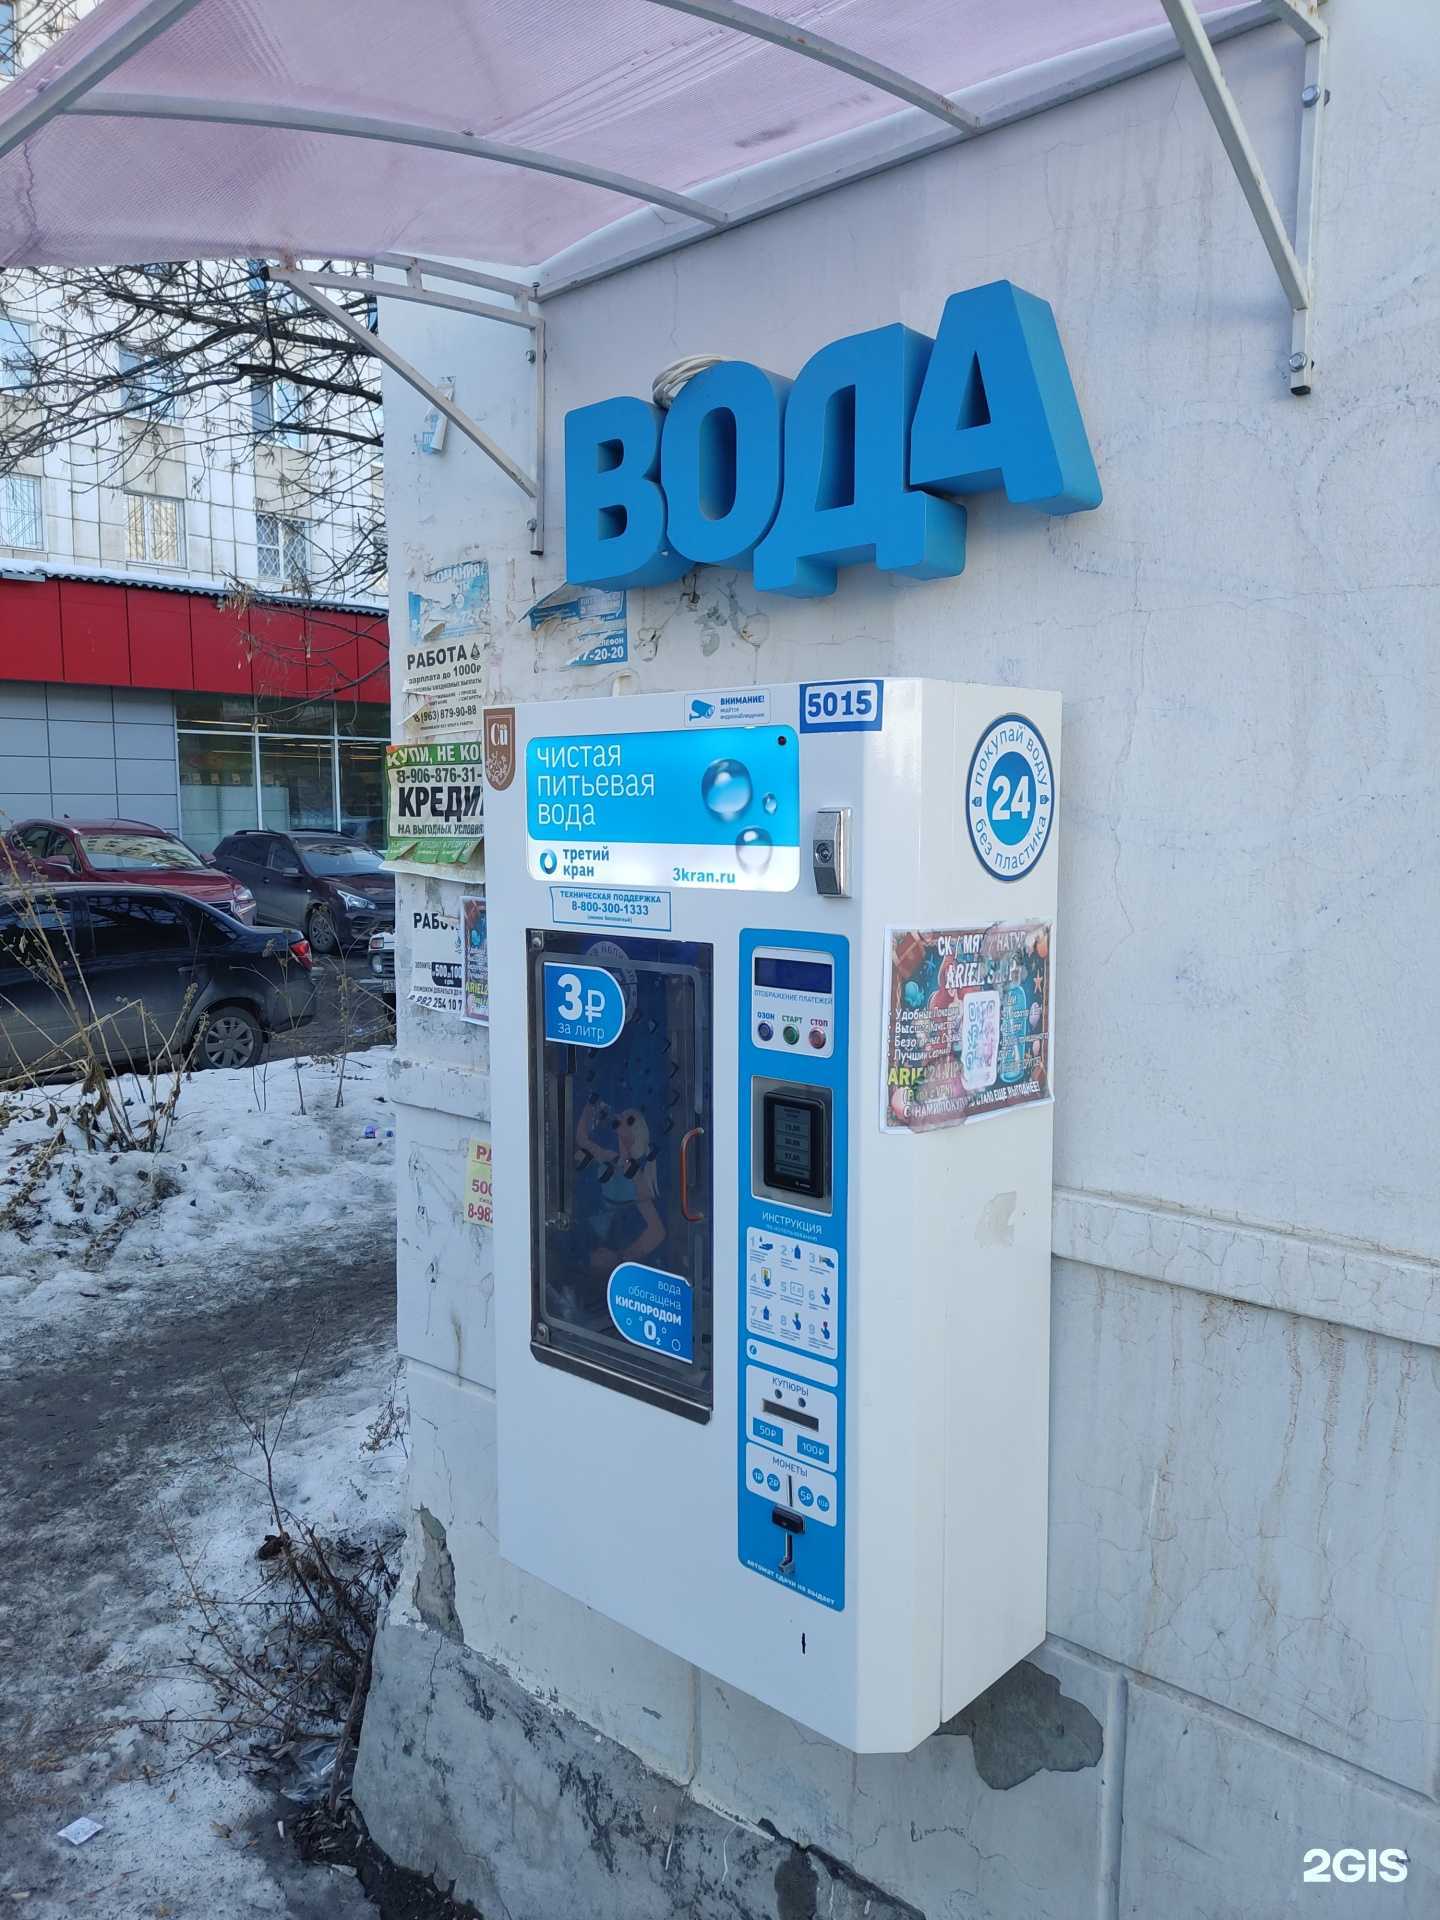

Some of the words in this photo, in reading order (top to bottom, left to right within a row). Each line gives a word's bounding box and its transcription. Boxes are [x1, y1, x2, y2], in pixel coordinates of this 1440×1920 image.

[564, 279, 1103, 598] ВОДА
[407, 644, 467, 670] РАБОТА
[443, 672, 451, 680] до
[720, 695, 765, 706] ВНИМАНИЕ!
[807, 690, 872, 718] 5015
[437, 745, 456, 761] НЕ
[536, 744, 621, 769] чистая
[975, 725, 1024, 786] покупай
[1026, 738, 1048, 786] воду
[537, 773, 655, 797] питьевая
[991, 775, 1031, 821] 24
[537, 803, 596, 832] вода
[397, 824, 410, 835] НА
[413, 824, 452, 836] ВЫГОДНЫХ
[975, 818, 993, 856] без
[994, 816, 1047, 870] пластика
[562, 846, 609, 862] третий
[563, 864, 595, 880] кран
[672, 867, 736, 884] 3kran.ru
[560, 890, 611, 902] ТЕХНИЧЕСКАЯ
[613, 893, 662, 904] ПОДДЕРЖКА
[571, 900, 649, 916] 8-800-300-1333
[781, 1015, 803, 1025] СТАРТ
[810, 1018, 828, 1028] СТОП
[557, 1023, 571, 1034] за
[575, 1024, 605, 1041] литр
[762, 1211, 823, 1235] ИНСТРУКЦИЯ
[628, 1285, 681, 1311] обогащена
[658, 1281, 681, 1295] вода
[615, 1295, 682, 1326] КИСЛОРОДОМ
[772, 1377, 809, 1397] КУПЮРЫ
[772, 1456, 808, 1477] МОНЕТЫ
